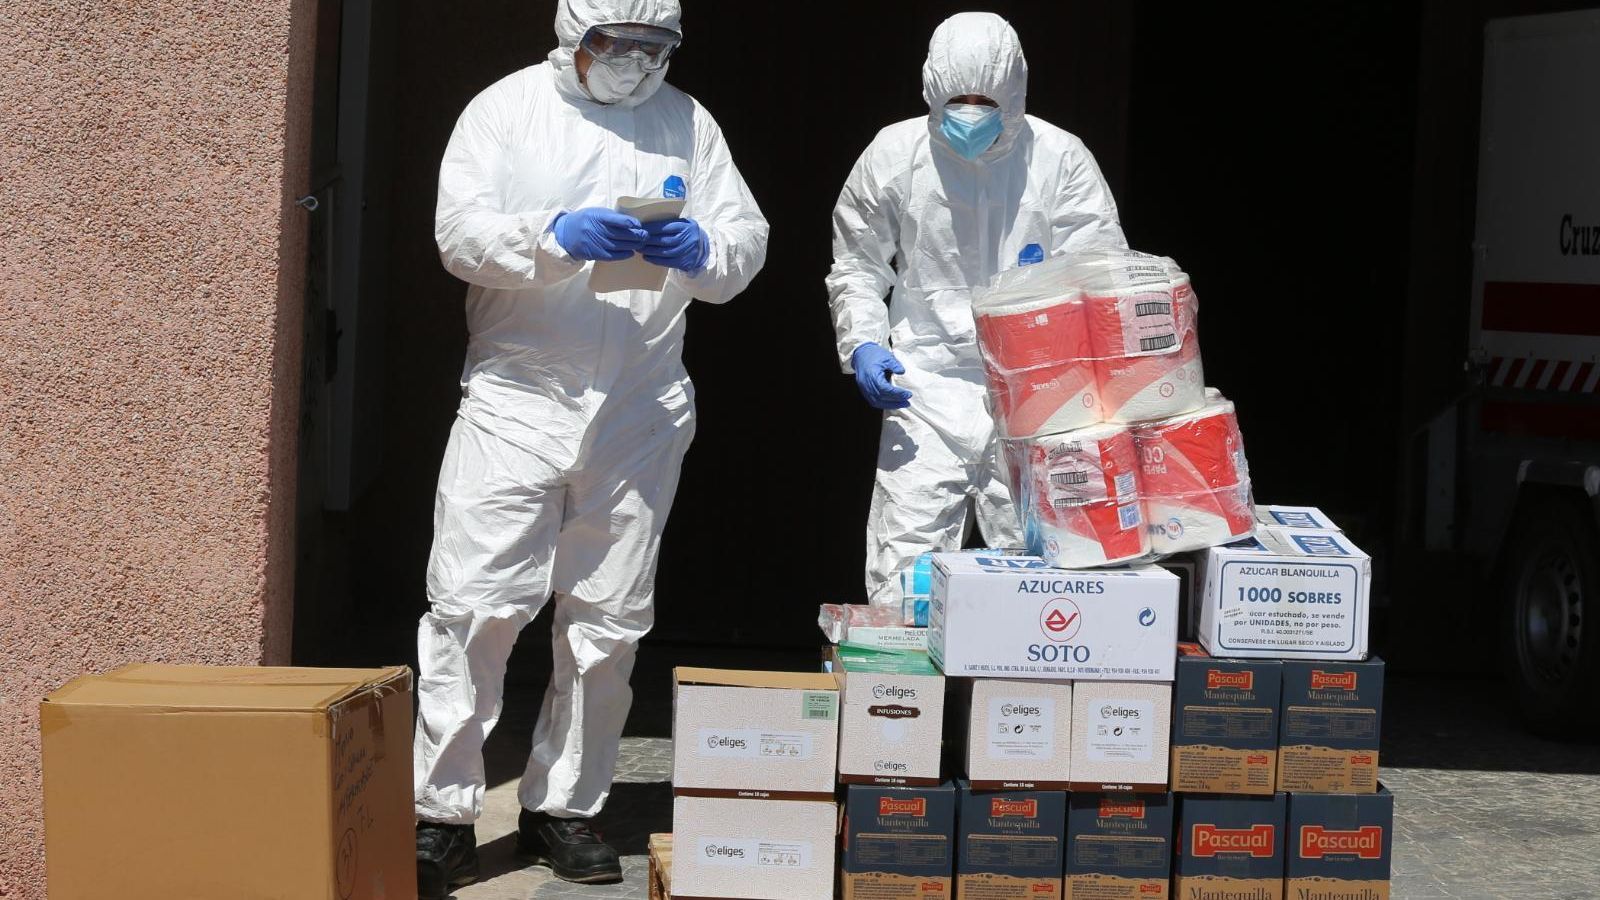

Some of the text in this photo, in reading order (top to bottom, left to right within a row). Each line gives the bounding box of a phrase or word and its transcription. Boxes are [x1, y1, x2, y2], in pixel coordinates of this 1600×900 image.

[1560, 213, 1600, 257] Cruz
[1239, 567, 1340, 578] AZUCAR BLANQUILLA
[1017, 580, 1105, 594] AZUCARES
[1237, 586, 1342, 604] 1000 SOBRES
[1322, 612, 1345, 620] vende
[1305, 621, 1319, 629] por
[1027, 645, 1091, 663] SOTO
[1208, 673, 1248, 685] Pascual
[1312, 674, 1352, 685] Pascual
[885, 683, 916, 698] eliges
[1203, 689, 1256, 702] Mantequilla
[1307, 689, 1359, 702] Mantequilla
[876, 708, 912, 716] INFUSIONES
[1012, 704, 1040, 716] eliges
[1112, 706, 1139, 718] eliges
[719, 736, 746, 748] eliges
[884, 760, 907, 771] eliges
[880, 800, 920, 812] Pascual
[992, 801, 1032, 813] Pascual
[876, 816, 929, 830] Mantequilla
[988, 817, 1040, 831] Mantequilla
[1096, 818, 1148, 831] Mantequilla
[1198, 830, 1268, 849] Pascual
[1305, 832, 1376, 849] Pascual
[717, 845, 744, 857] eliges
[1189, 887, 1273, 900] Mantequilla
[1297, 888, 1381, 900] Mantequilla
